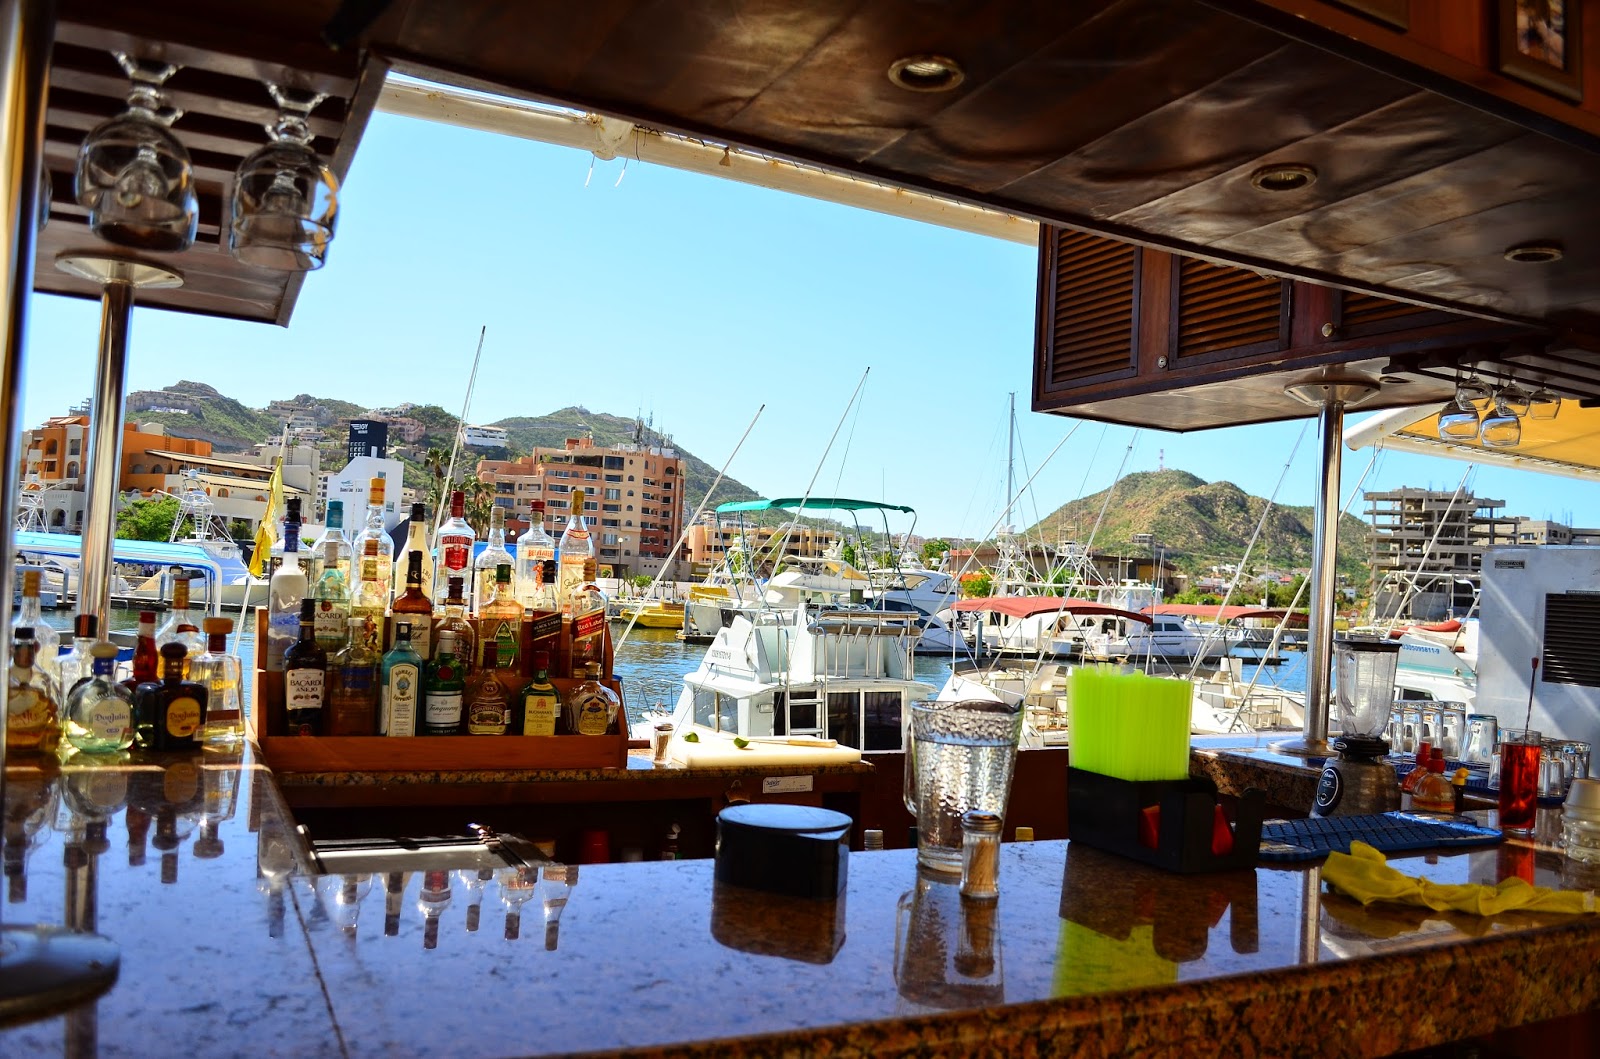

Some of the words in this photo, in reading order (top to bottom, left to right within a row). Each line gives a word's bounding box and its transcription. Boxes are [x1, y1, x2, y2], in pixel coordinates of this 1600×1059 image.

[315, 612, 343, 620] ACARDI
[577, 622, 590, 631] Red
[589, 616, 604, 627] Label
[429, 703, 459, 713] Tanqueray
